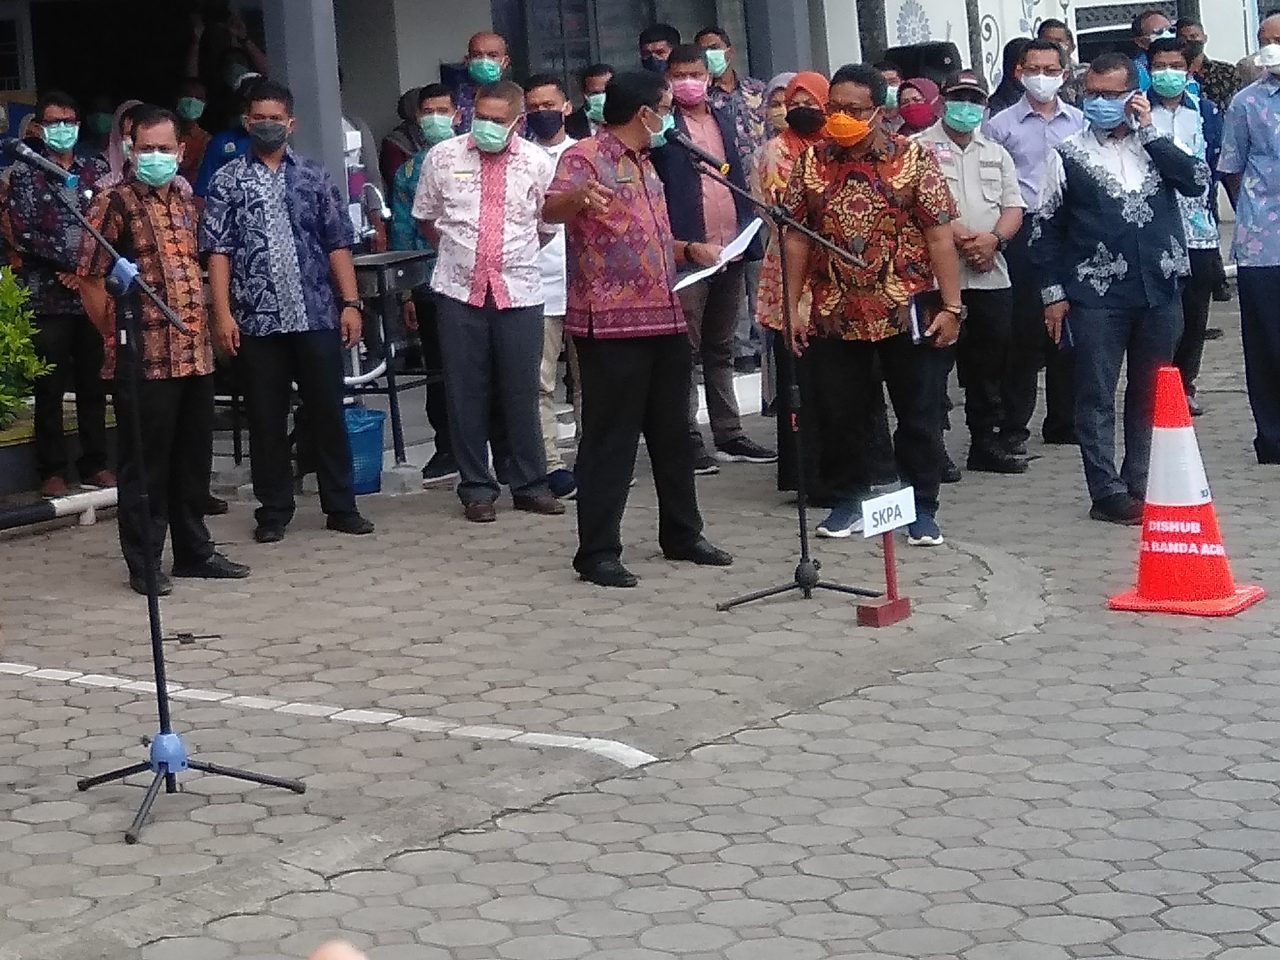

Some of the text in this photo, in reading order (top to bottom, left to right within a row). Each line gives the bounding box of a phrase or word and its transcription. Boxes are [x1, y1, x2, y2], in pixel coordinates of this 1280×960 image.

[871, 503, 903, 528] SKPA
[1148, 521, 1201, 534] DISHUB
[1151, 541, 1200, 554] BANDA
